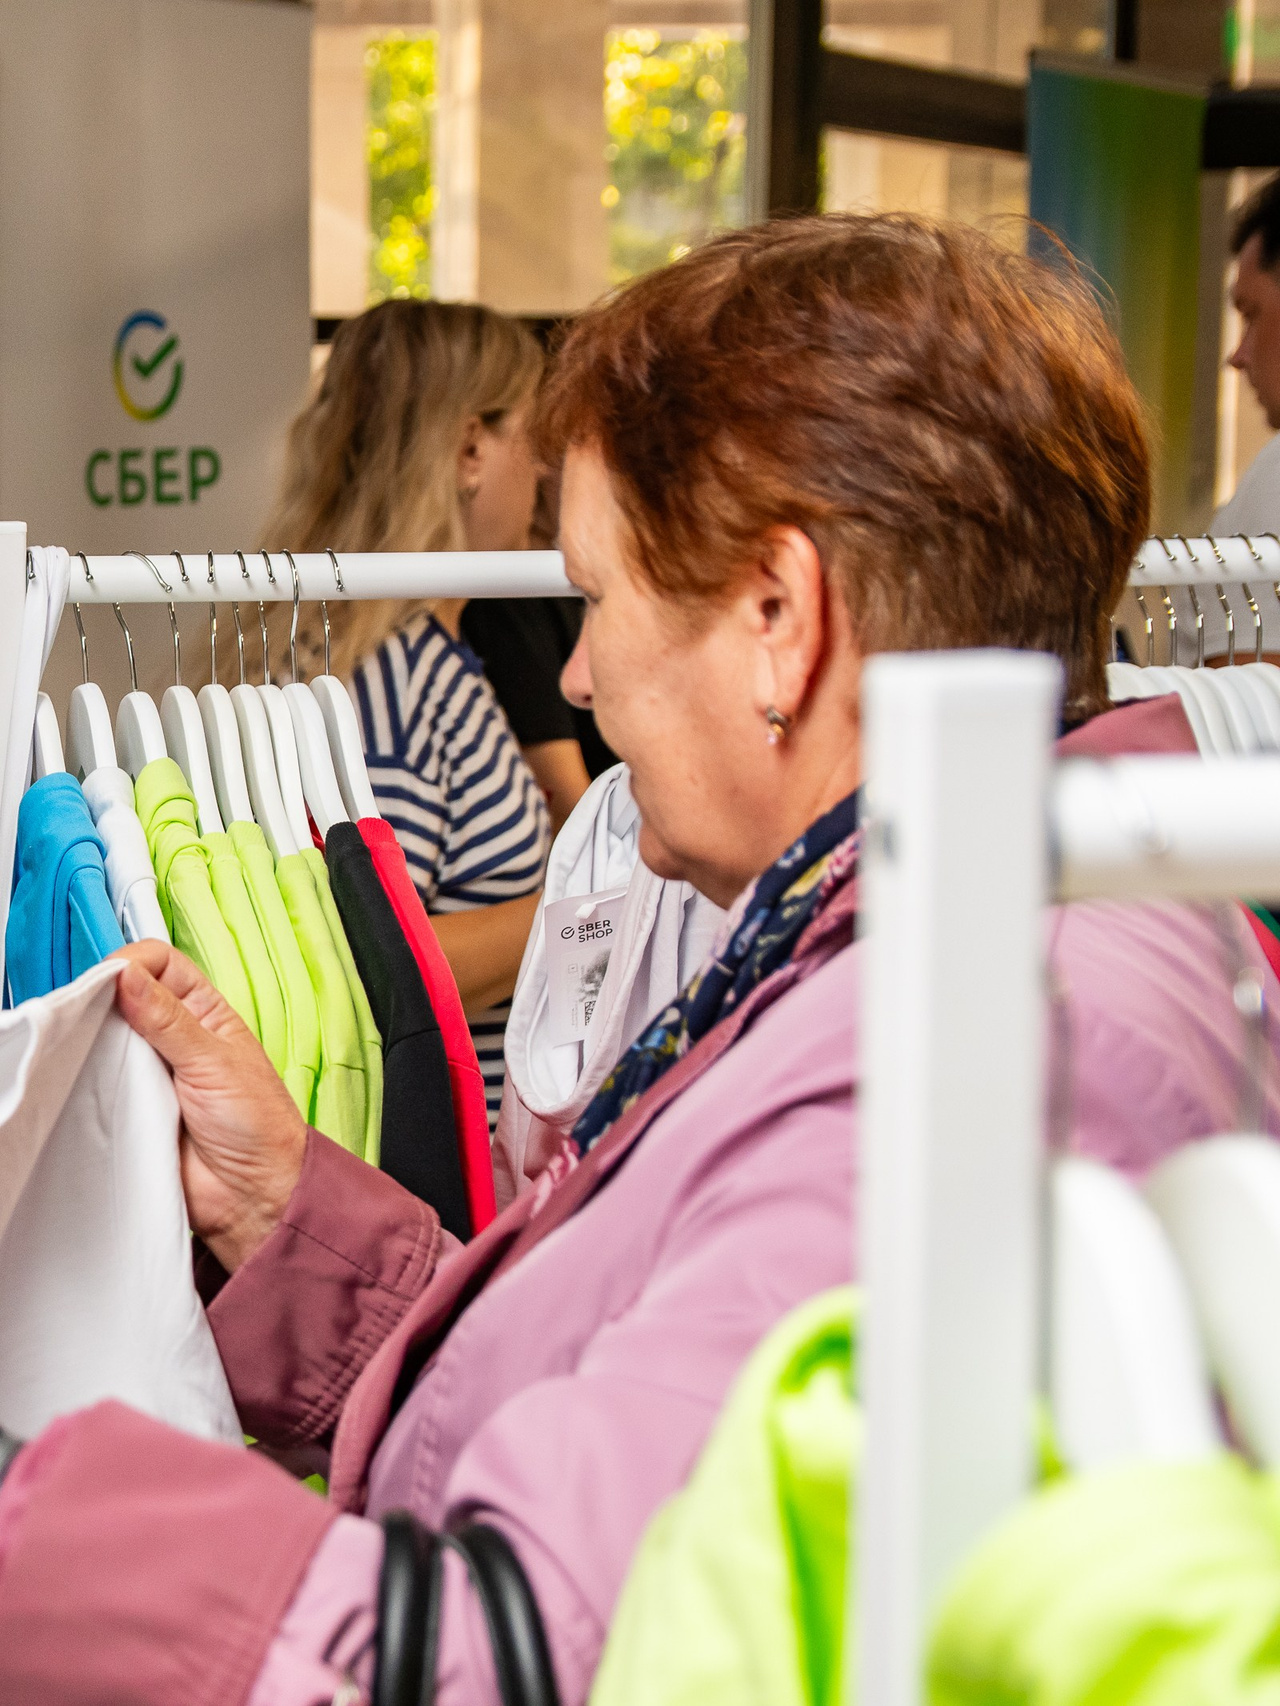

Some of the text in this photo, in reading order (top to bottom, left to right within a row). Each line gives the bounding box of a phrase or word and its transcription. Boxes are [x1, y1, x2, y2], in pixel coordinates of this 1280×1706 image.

[84, 448, 222, 508] СБЕР
[577, 919, 611, 934] SBER
[578, 928, 614, 943] SHOP
